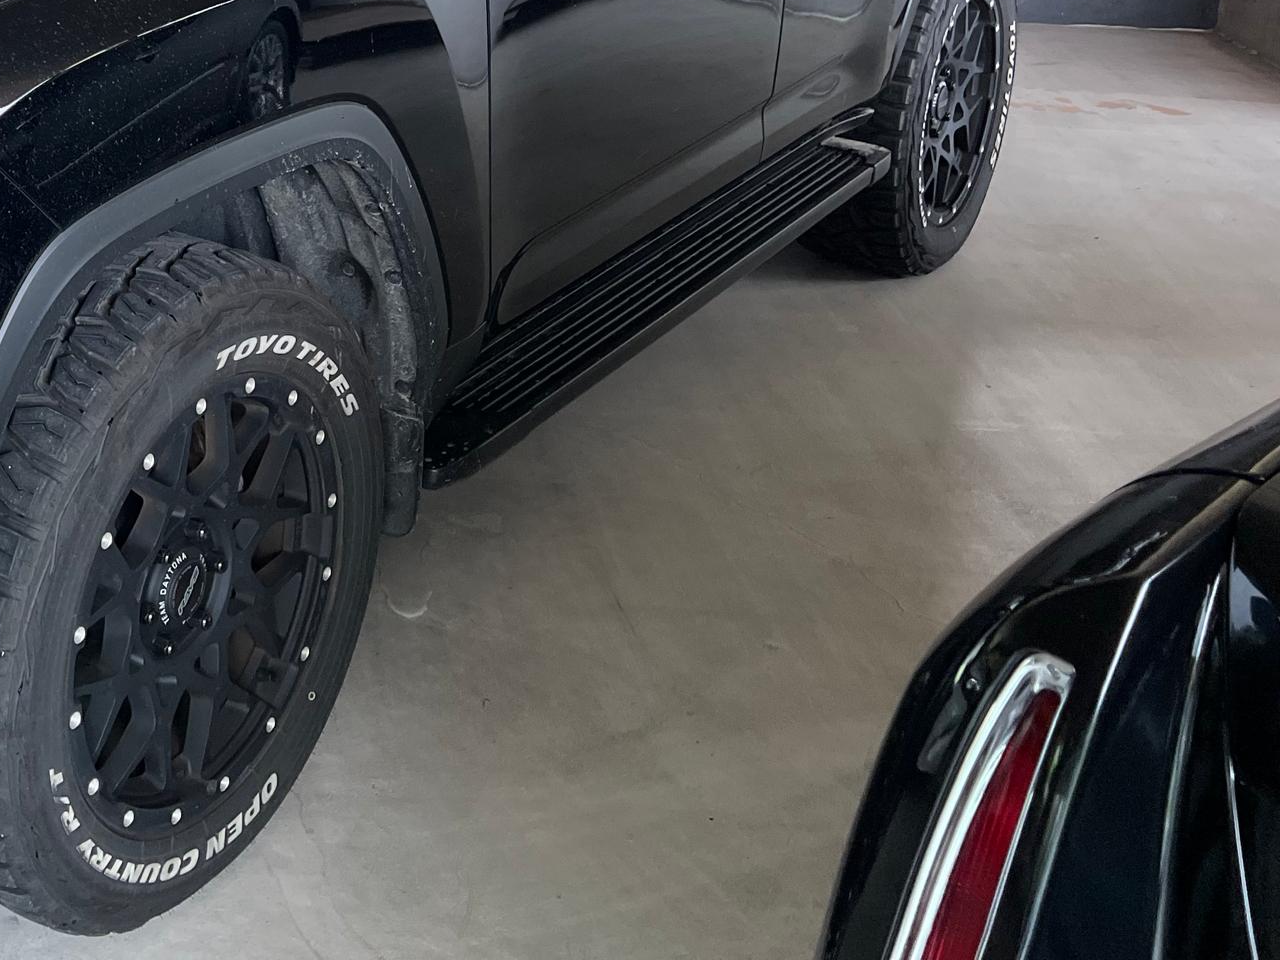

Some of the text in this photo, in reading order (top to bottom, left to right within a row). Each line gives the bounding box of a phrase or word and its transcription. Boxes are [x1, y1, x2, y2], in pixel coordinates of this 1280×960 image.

[1006, 20, 1017, 85] TOYO
[215, 334, 360, 417] TOYO TIRES
[159, 552, 187, 626] TEAM DAYTONA
[48, 768, 278, 884] OPEN COUNTRY R/T
